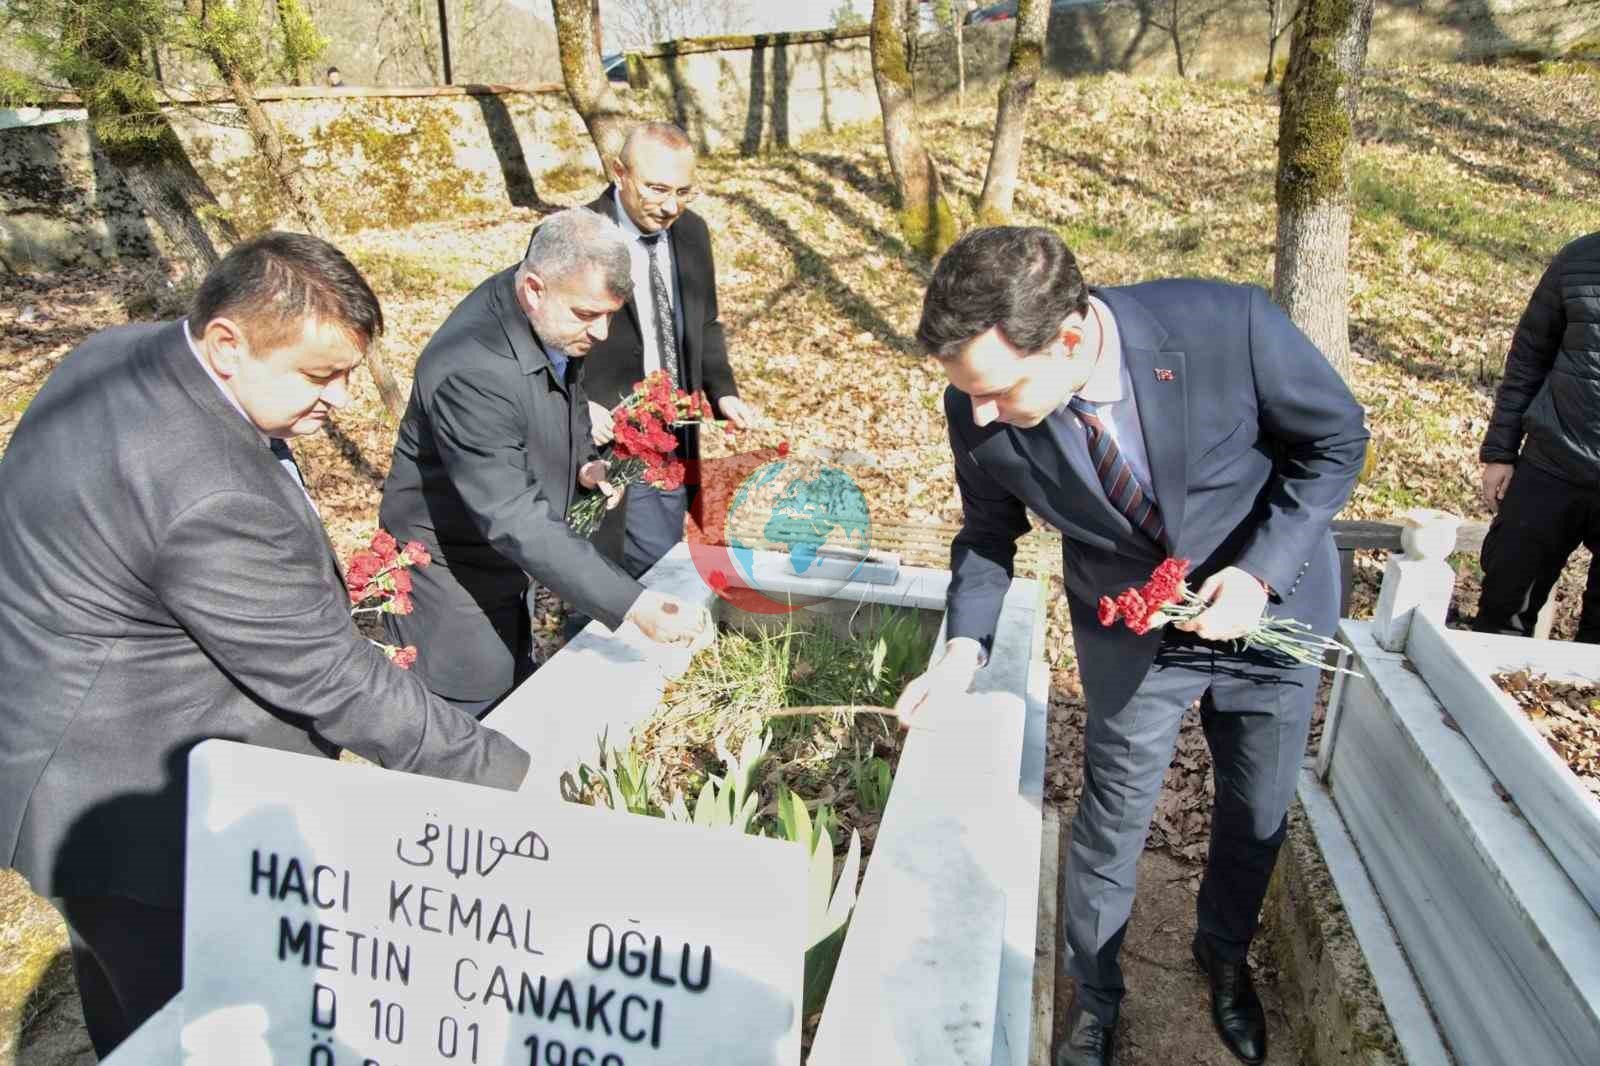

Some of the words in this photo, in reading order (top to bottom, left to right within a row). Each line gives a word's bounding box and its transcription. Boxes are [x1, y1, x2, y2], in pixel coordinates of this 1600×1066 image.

[251, 850, 350, 913] HACI
[389, 880, 545, 956] KEMAL
[587, 918, 712, 994] OĞLU
[278, 915, 410, 986] METİN
[454, 957, 663, 1050] ÇANAKCI
[312, 983, 336, 1031] D
[369, 998, 404, 1044] 10
[438, 1015, 479, 1064] 01
[524, 1034, 624, 1066] 19
